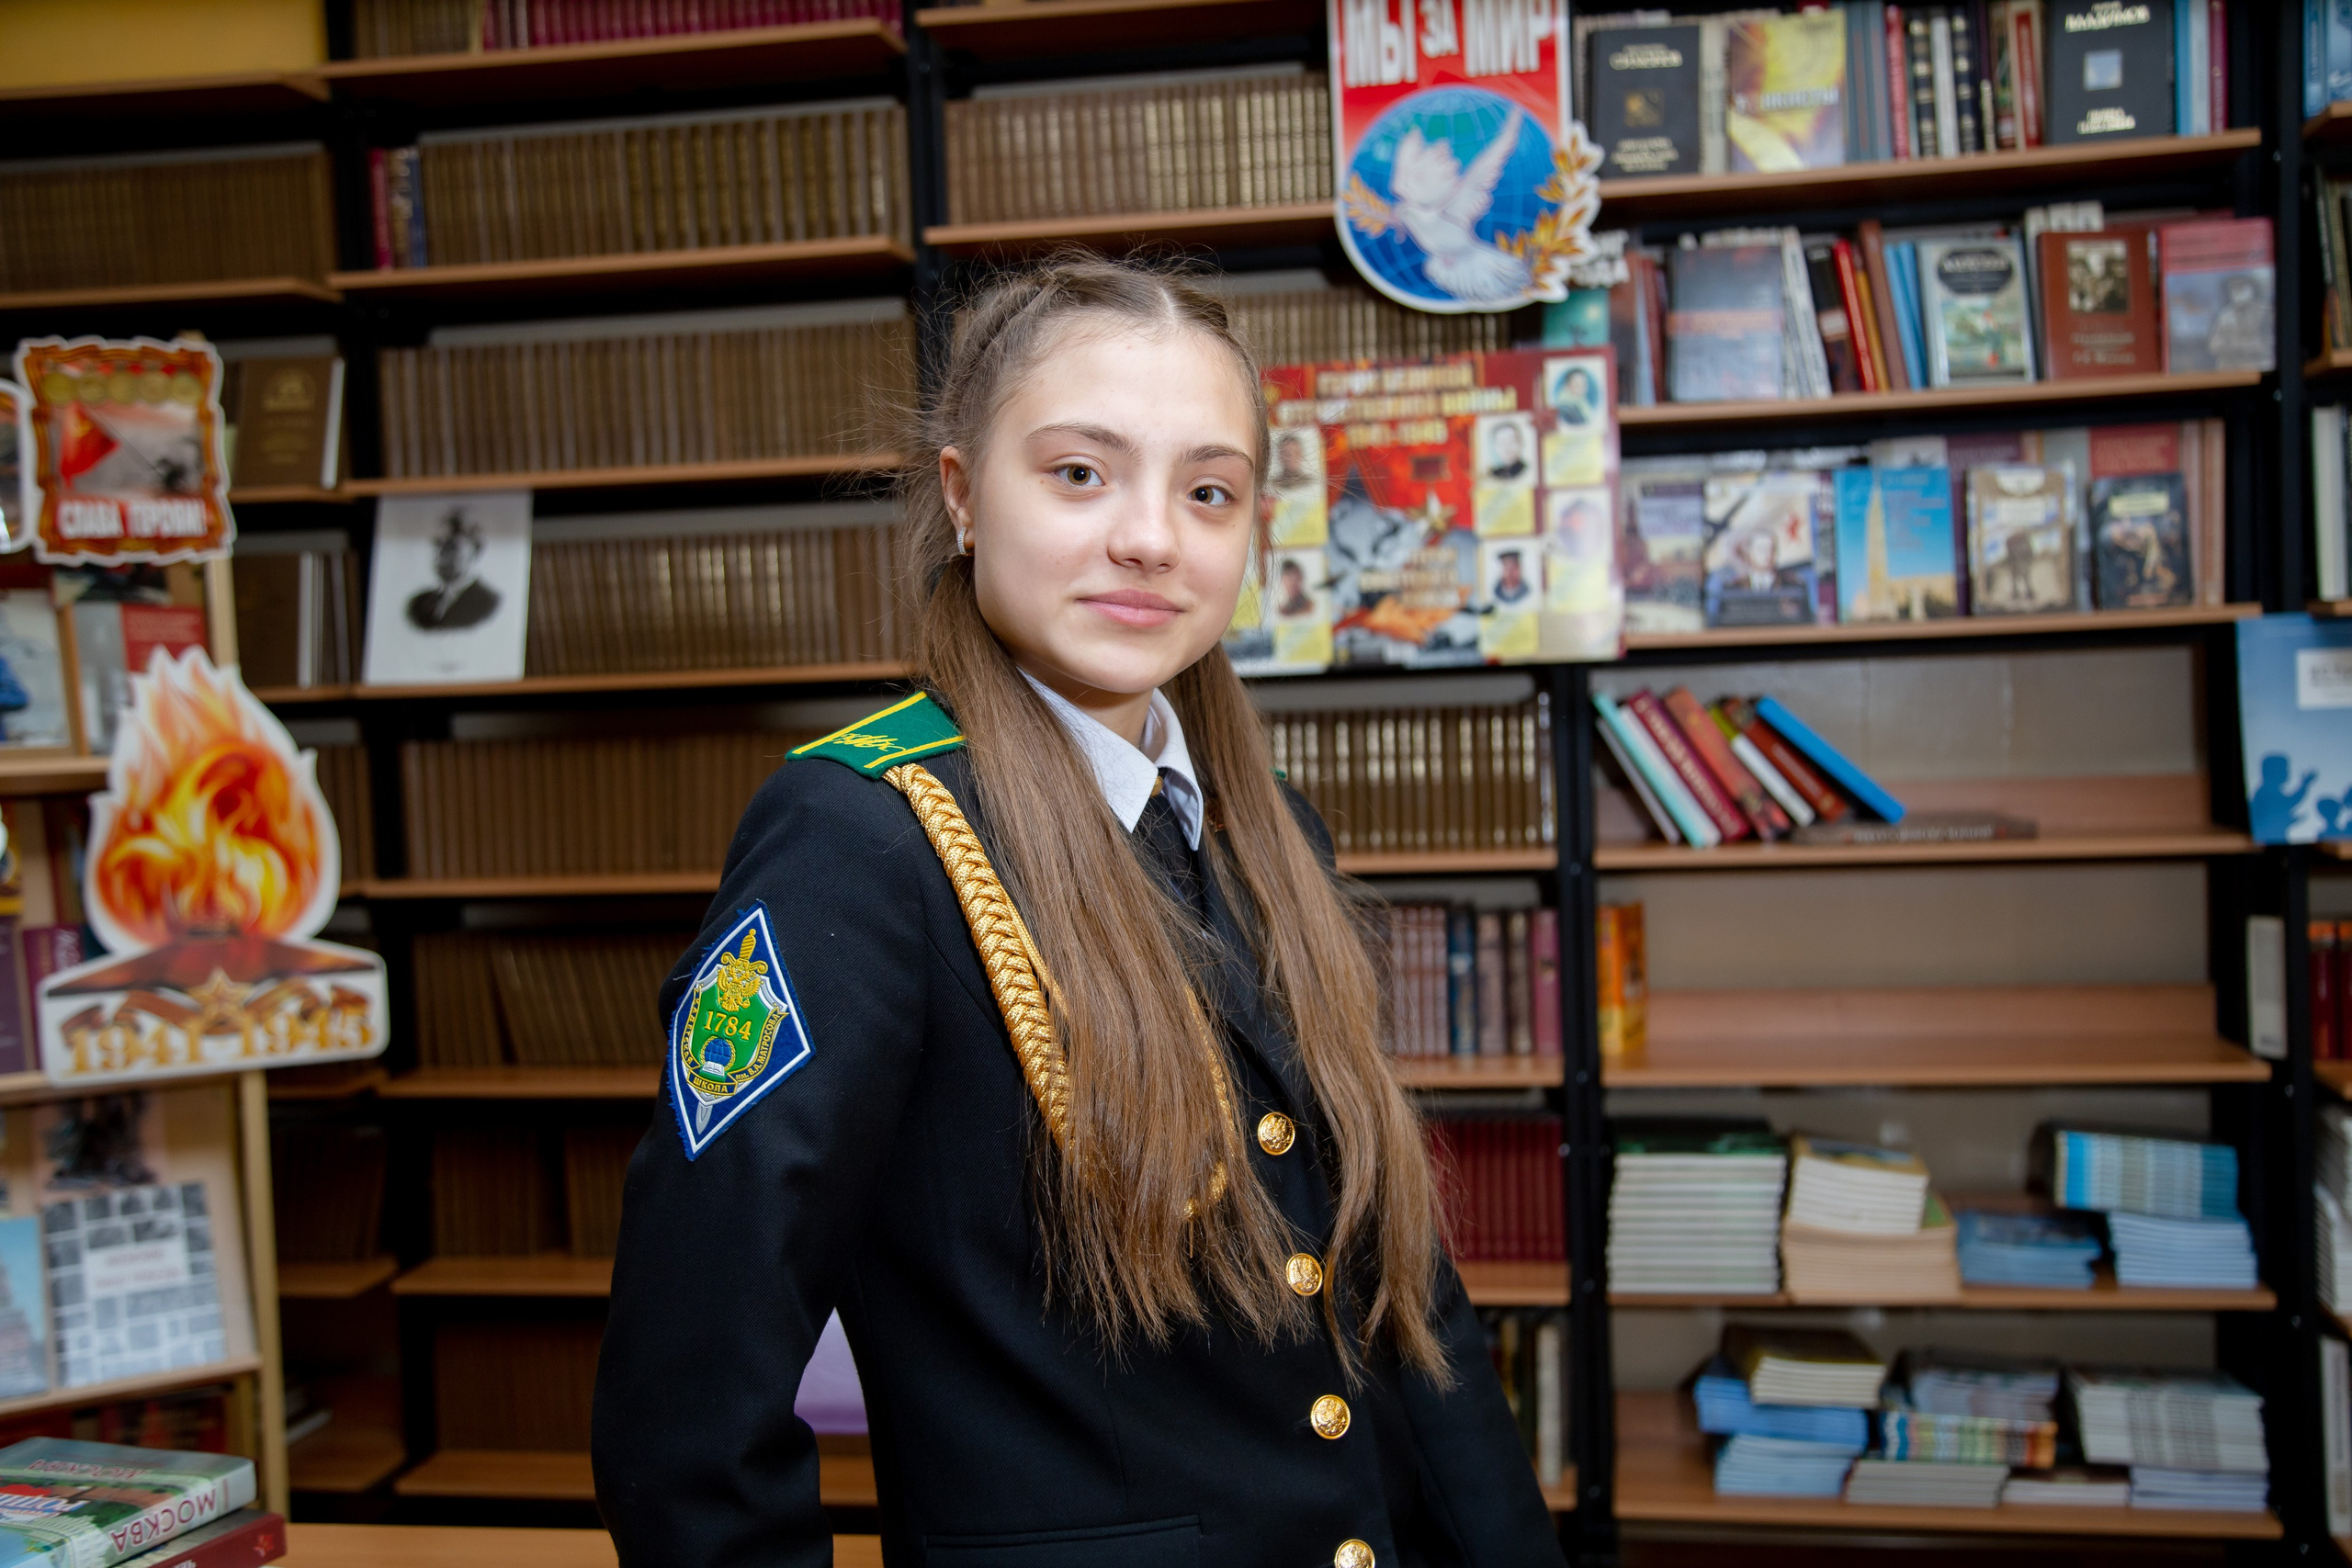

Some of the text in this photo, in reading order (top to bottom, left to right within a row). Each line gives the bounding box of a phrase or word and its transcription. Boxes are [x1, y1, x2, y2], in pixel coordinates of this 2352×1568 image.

[1344, 0, 1553, 87] МЫ ЗА МИР
[704, 1011, 752, 1041] 1784
[693, 1077, 729, 1093] ШКОЛА
[108, 1488, 218, 1554] МОСКВА
